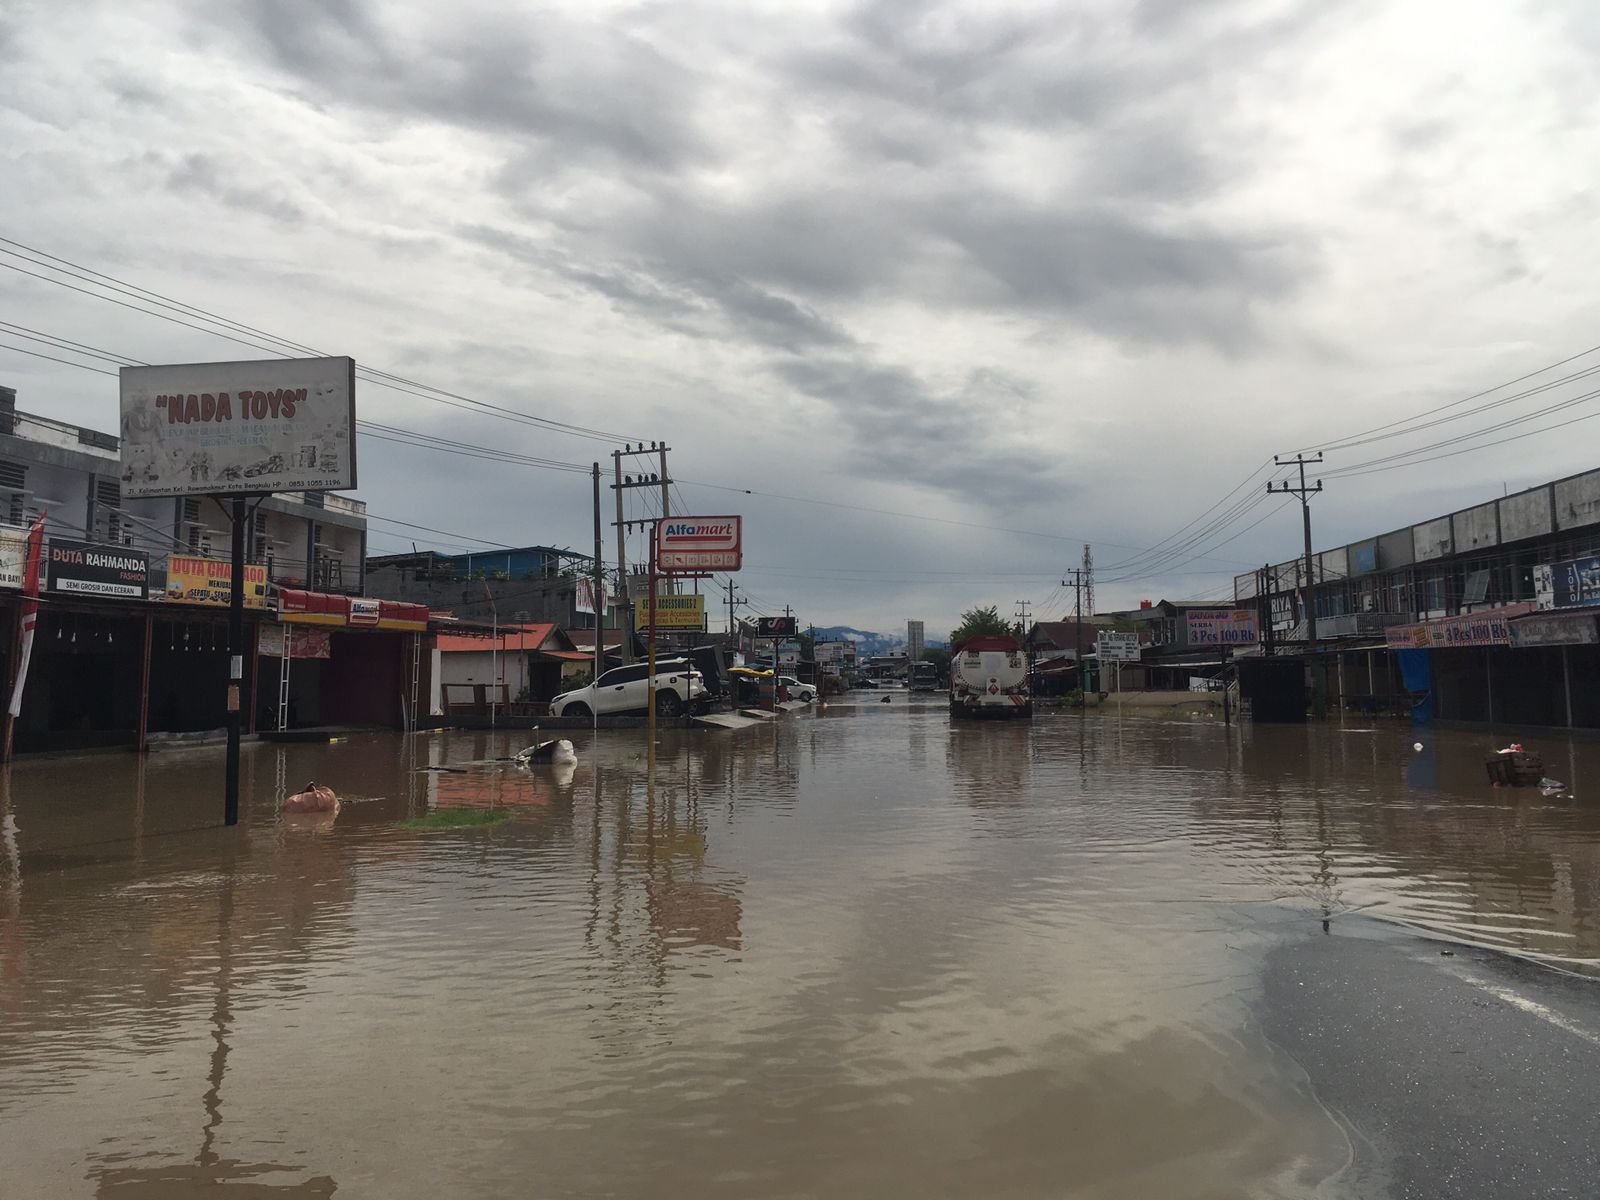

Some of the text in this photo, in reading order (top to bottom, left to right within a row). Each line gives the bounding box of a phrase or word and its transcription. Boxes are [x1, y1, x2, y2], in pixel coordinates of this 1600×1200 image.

[139, 486, 171, 494] Kalimantan
[244, 482, 271, 490] Bengkulu
[665, 523, 733, 536] Alfamart
[53, 548, 146, 572] DUTA RAHMANDA
[172, 558, 205, 577] DUTA
[8, 574, 21, 583] BAYI
[119, 571, 146, 581] FASHION
[80, 582, 101, 591] GROSIR
[101, 584, 114, 592] DAN
[114, 585, 135, 594] ECERAN
[1566, 567, 1577, 602] TOKO
[190, 588, 211, 599] SEPATU
[658, 598, 692, 609] ACCESSORIES
[693, 598, 697, 608] 2
[1271, 595, 1291, 613] RIYA
[1191, 629, 1254, 641] 3 Pcs 100 Rb
[1446, 628, 1452, 642] 3
[1453, 627, 1471, 641] Pcs
[1472, 625, 1490, 641] 100
[1491, 623, 1508, 640] Rb
